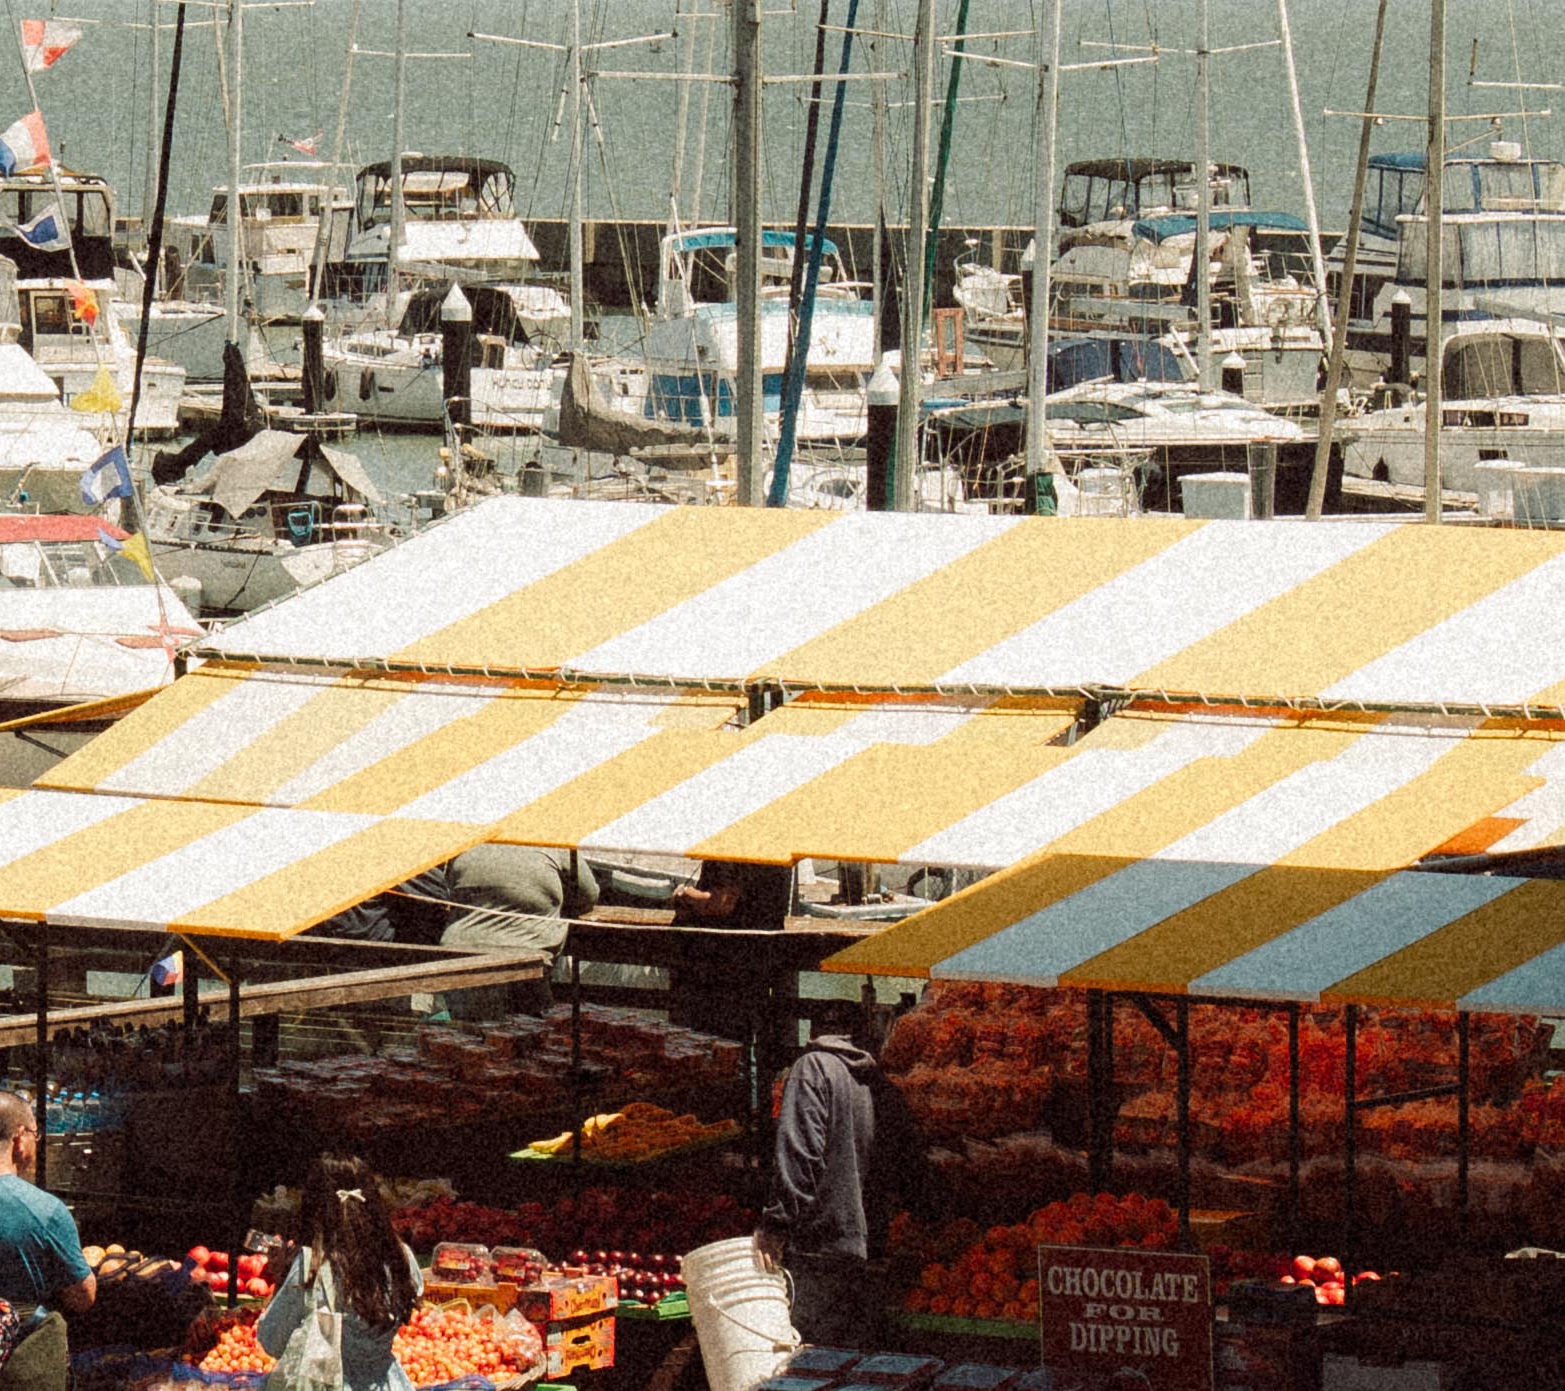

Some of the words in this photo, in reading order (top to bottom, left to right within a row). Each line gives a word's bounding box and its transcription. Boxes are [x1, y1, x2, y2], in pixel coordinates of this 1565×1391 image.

[1047, 1266, 1199, 1303] CHOCOLATE
[1084, 1304, 1165, 1320] FOR
[1069, 1322, 1180, 1357] DIPPING
